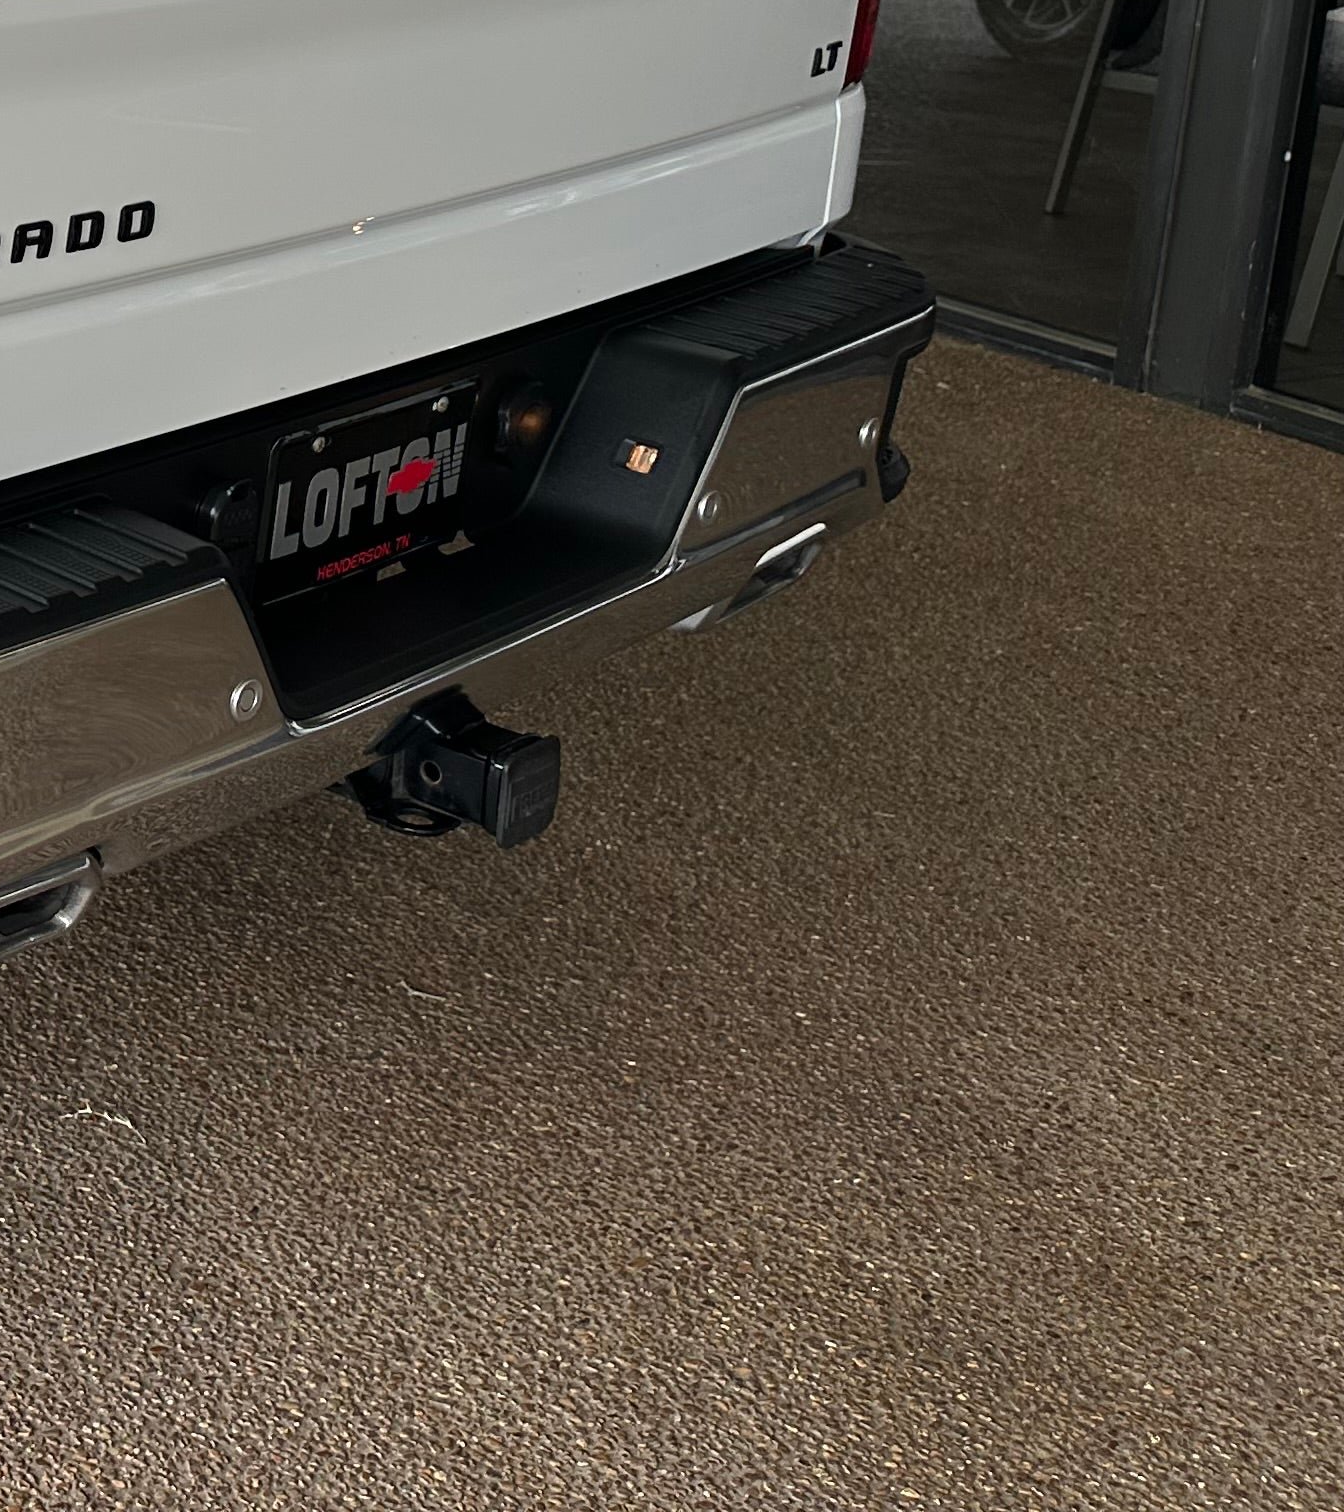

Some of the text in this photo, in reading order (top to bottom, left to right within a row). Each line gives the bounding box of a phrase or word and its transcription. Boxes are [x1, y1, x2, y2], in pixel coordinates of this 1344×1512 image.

[810, 40, 844, 78] LT
[269, 421, 469, 561] LOFTON
[395, 532, 412, 553] TN
